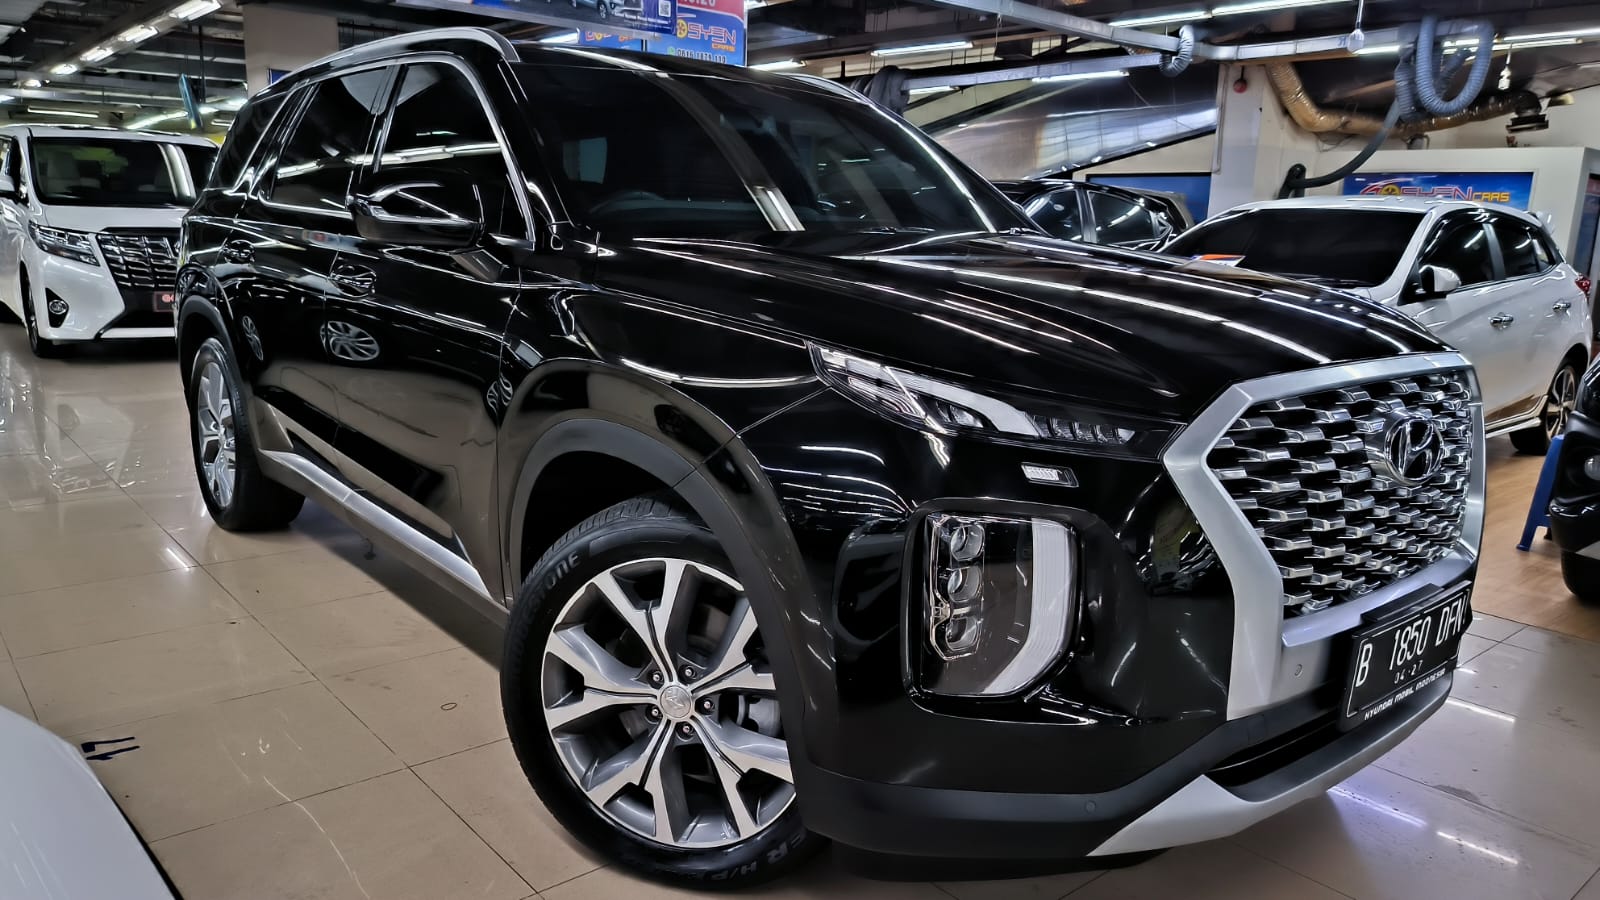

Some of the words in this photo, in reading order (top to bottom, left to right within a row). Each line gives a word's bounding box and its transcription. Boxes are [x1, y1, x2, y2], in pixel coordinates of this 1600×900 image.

[1472, 191, 1510, 202] CARS
[1355, 643, 1373, 687] B
[1389, 615, 1432, 671] 1850
